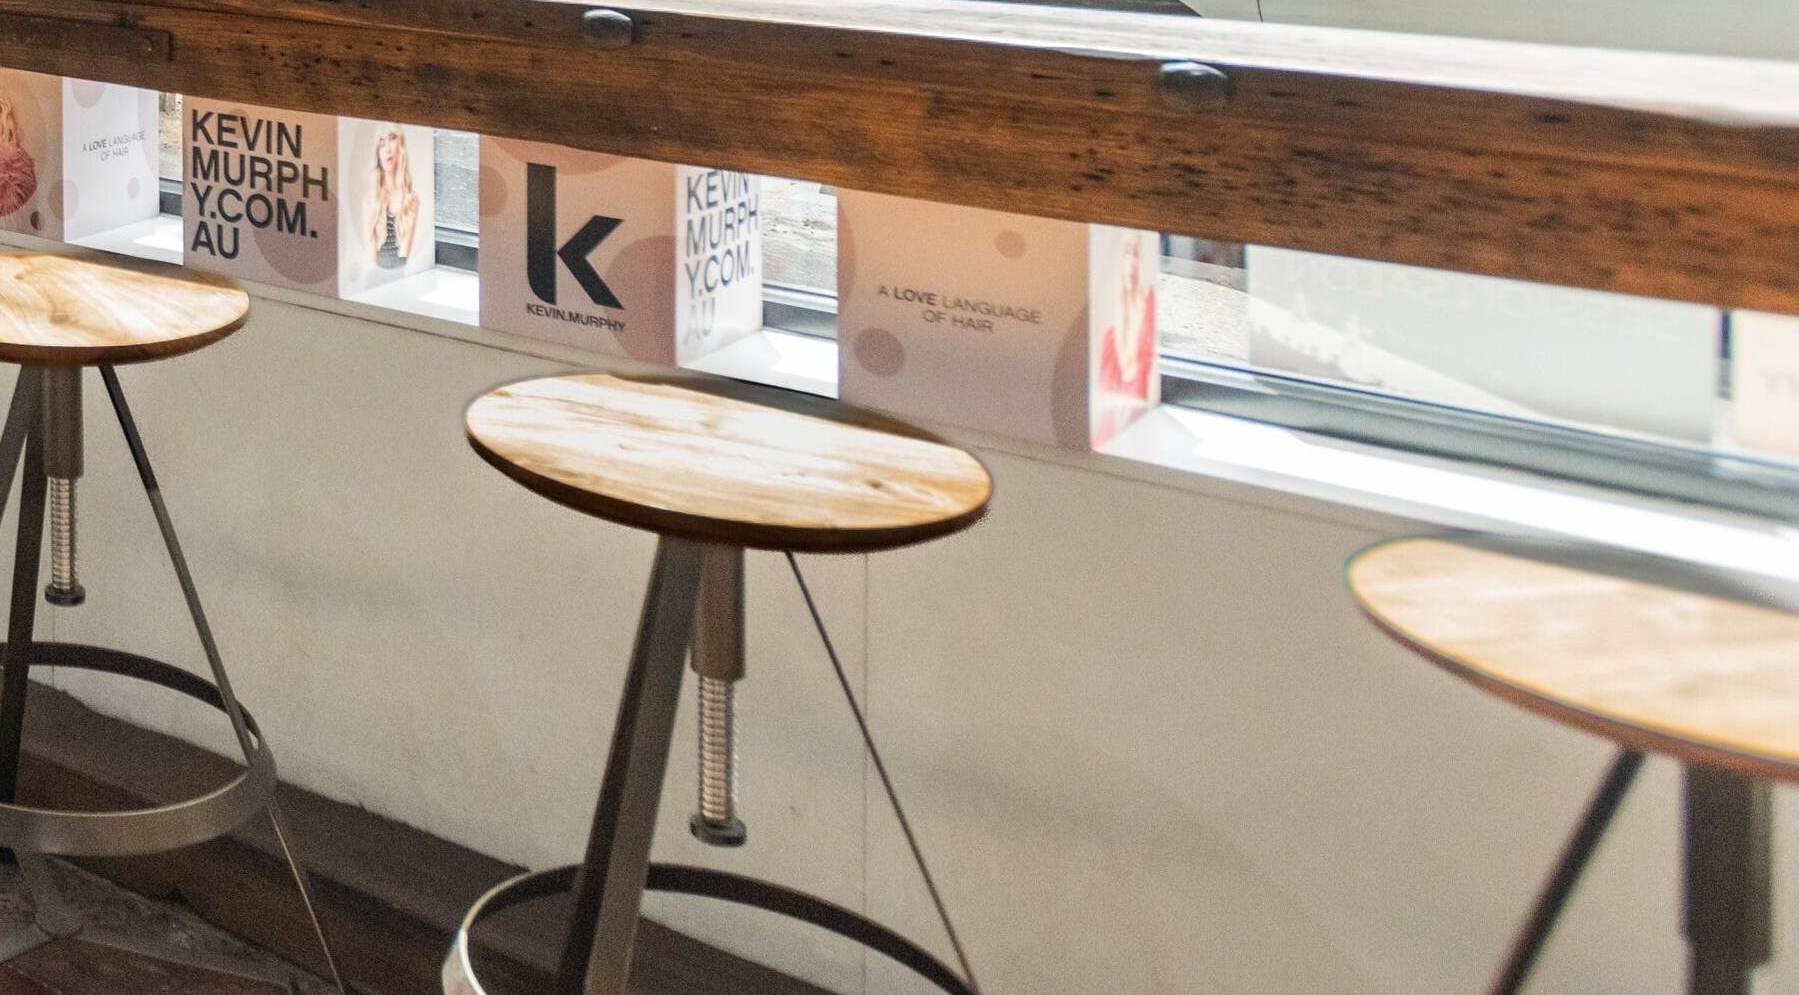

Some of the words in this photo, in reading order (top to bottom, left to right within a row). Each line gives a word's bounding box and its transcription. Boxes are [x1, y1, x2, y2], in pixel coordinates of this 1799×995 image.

[81, 142, 89, 154] A
[88, 138, 108, 152] LOVE
[108, 130, 146, 148] LANGUAGE
[100, 149, 111, 162] OF
[191, 108, 303, 160] KEVIN
[191, 145, 329, 202] MURPH
[686, 168, 751, 215] KEVIN
[190, 181, 318, 239] Y.COM.
[686, 193, 760, 260] MURPH
[191, 220, 240, 260] AU
[684, 240, 755, 302] Y.COM.
[526, 303, 627, 333] KEVIN.MURPHY
[685, 297, 716, 347] AU
[877, 284, 890, 299] A
[892, 286, 938, 307] LOVE
[941, 295, 1043, 325] LANGUAGE
[921, 308, 948, 325] OF
[951, 315, 996, 334] HAIR
